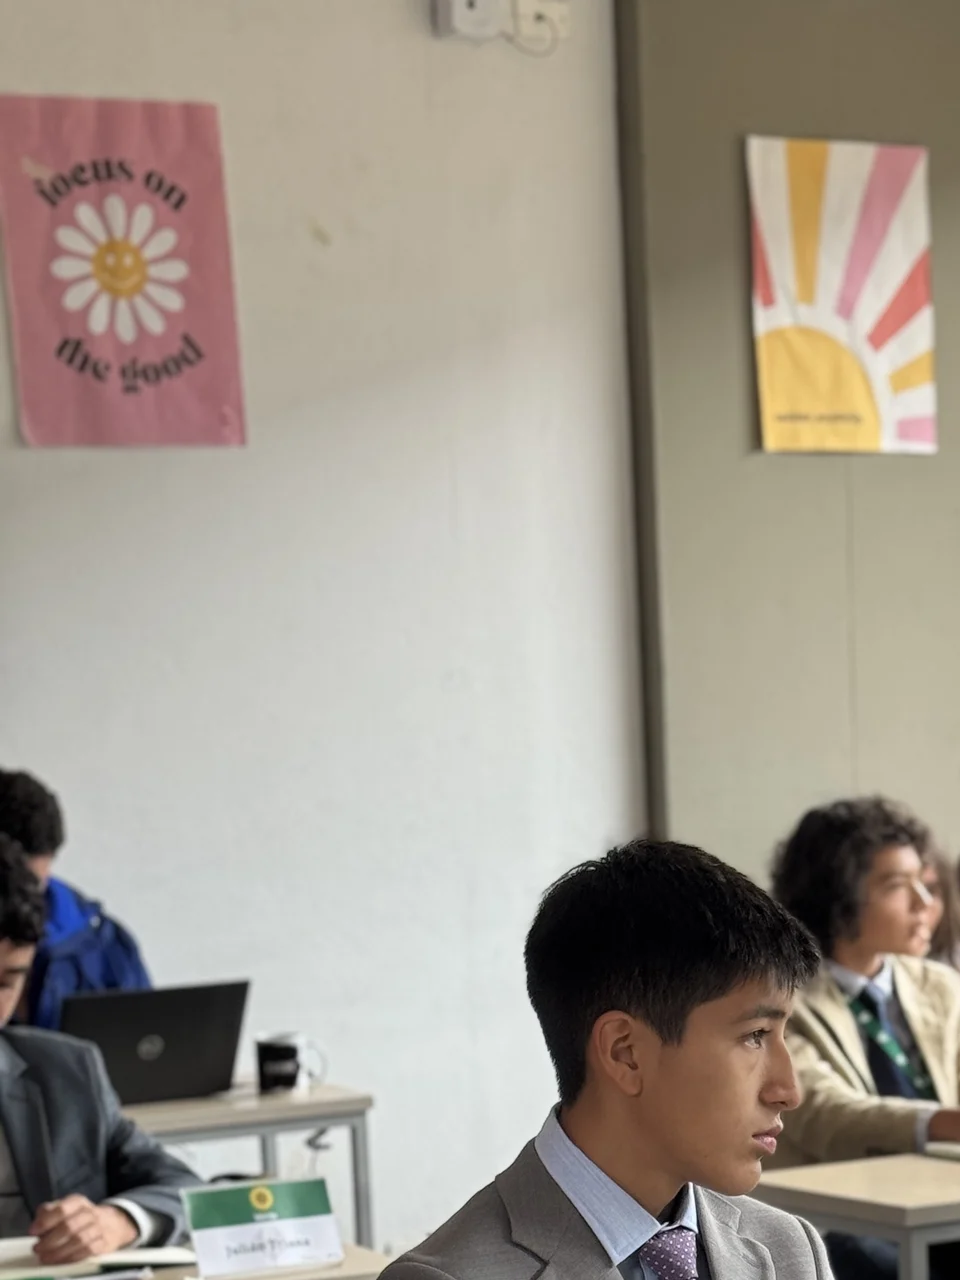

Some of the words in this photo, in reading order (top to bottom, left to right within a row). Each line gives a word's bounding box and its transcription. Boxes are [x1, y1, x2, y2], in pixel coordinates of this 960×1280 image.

[34, 158, 134, 208] focus
[143, 170, 188, 212] on
[54, 336, 110, 383] the
[120, 332, 205, 395] good
